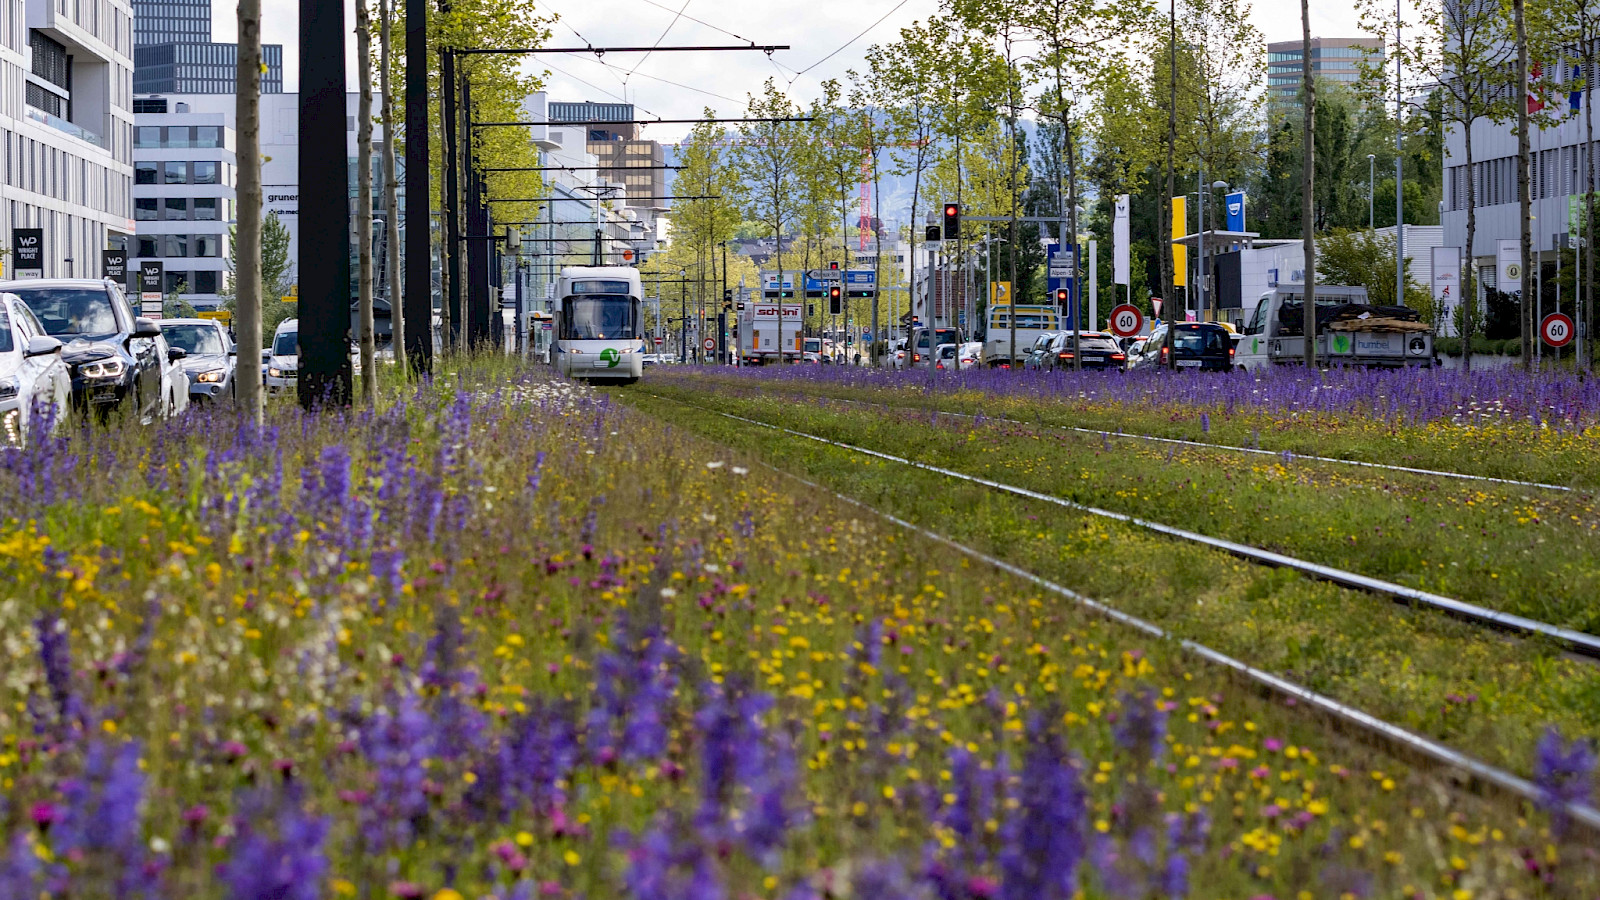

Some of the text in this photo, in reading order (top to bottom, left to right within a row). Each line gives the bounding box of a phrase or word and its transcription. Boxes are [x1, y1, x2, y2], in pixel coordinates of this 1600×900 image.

[1120, 316, 1132, 328] 60
[1550, 324, 1564, 336] 60
[1358, 341, 1390, 349] humbel
